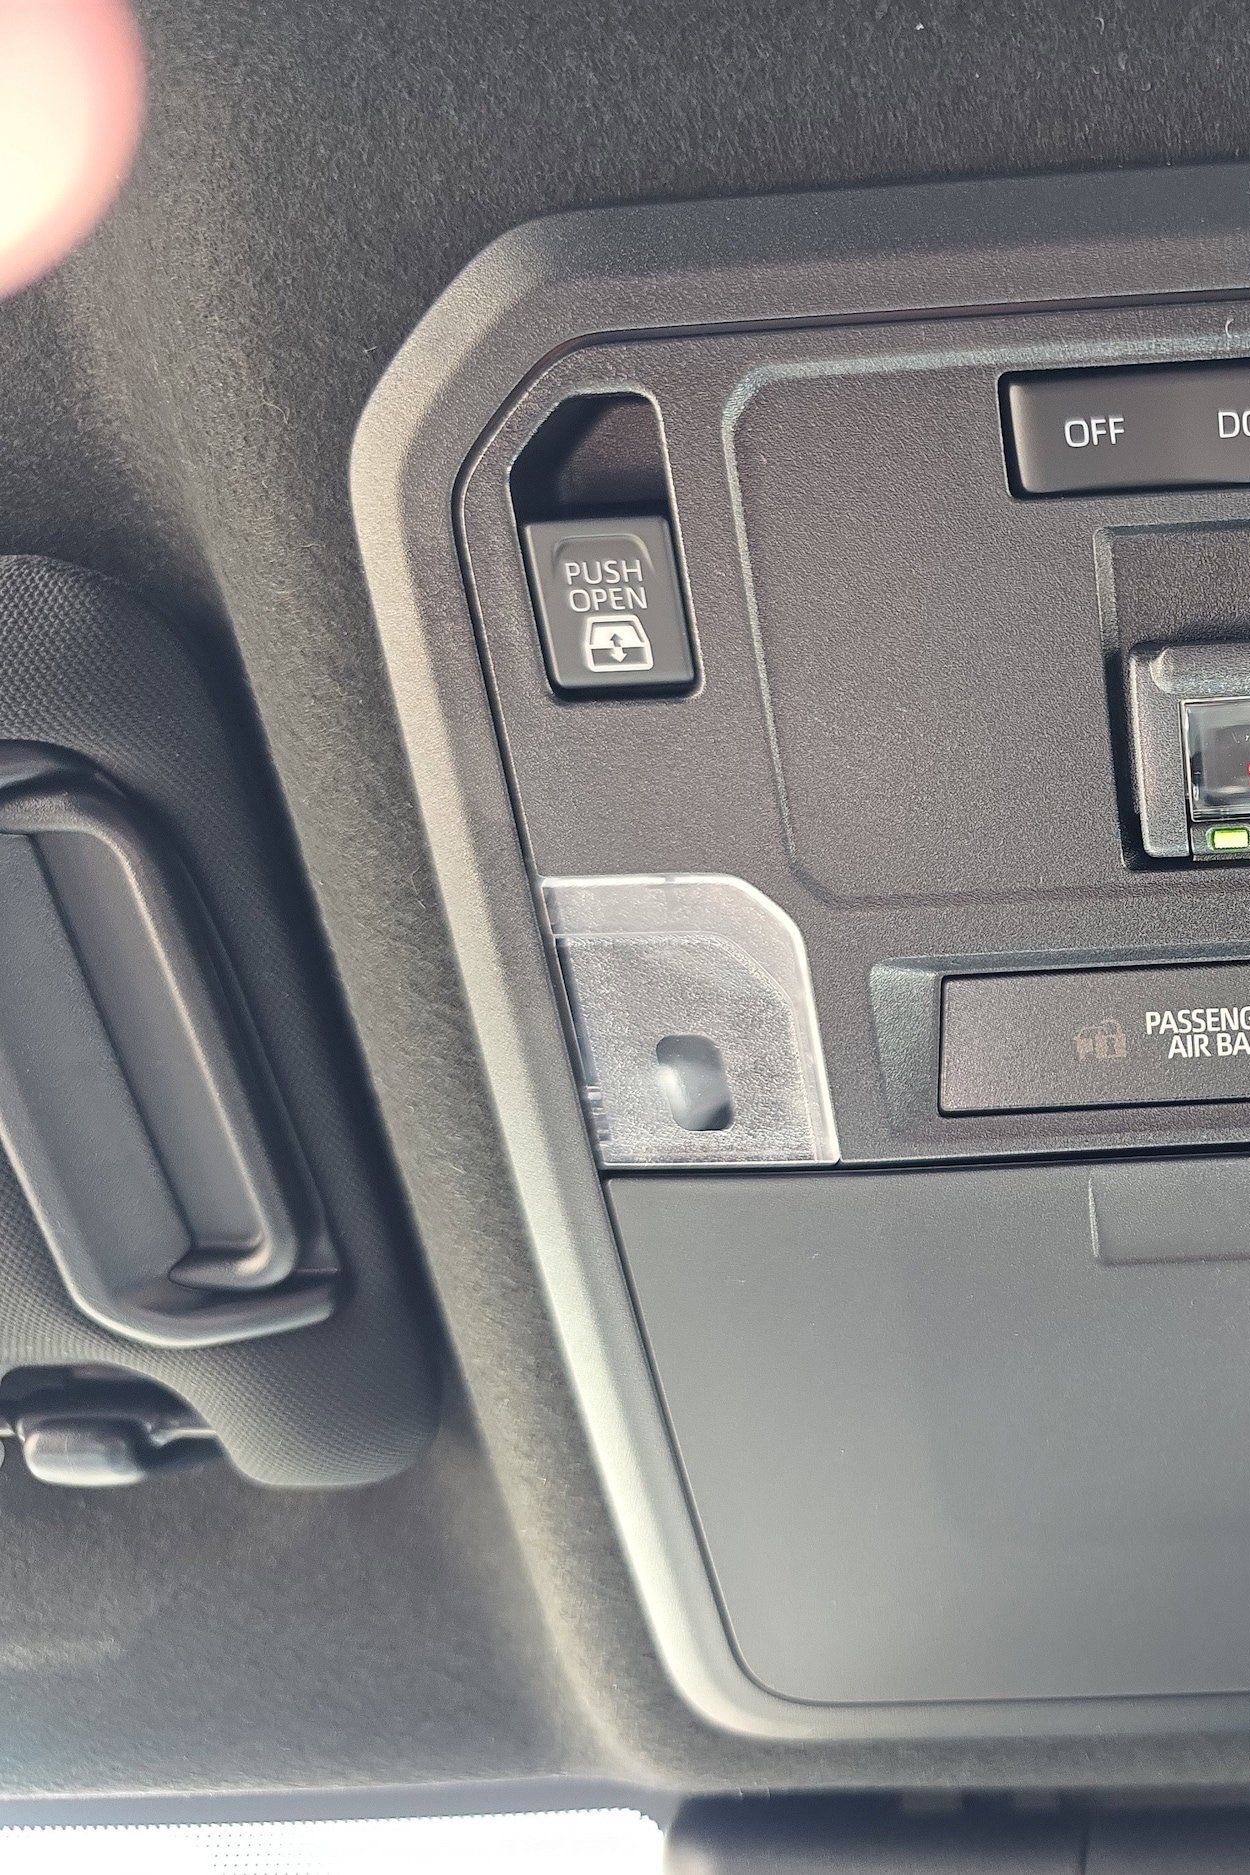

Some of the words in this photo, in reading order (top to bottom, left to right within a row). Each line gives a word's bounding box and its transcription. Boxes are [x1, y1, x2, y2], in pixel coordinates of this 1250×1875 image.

[1064, 417, 1126, 448] OFF
[565, 559, 643, 585] PUSH
[569, 587, 648, 612] OPEN
[1168, 1033, 1212, 1059] AIR
